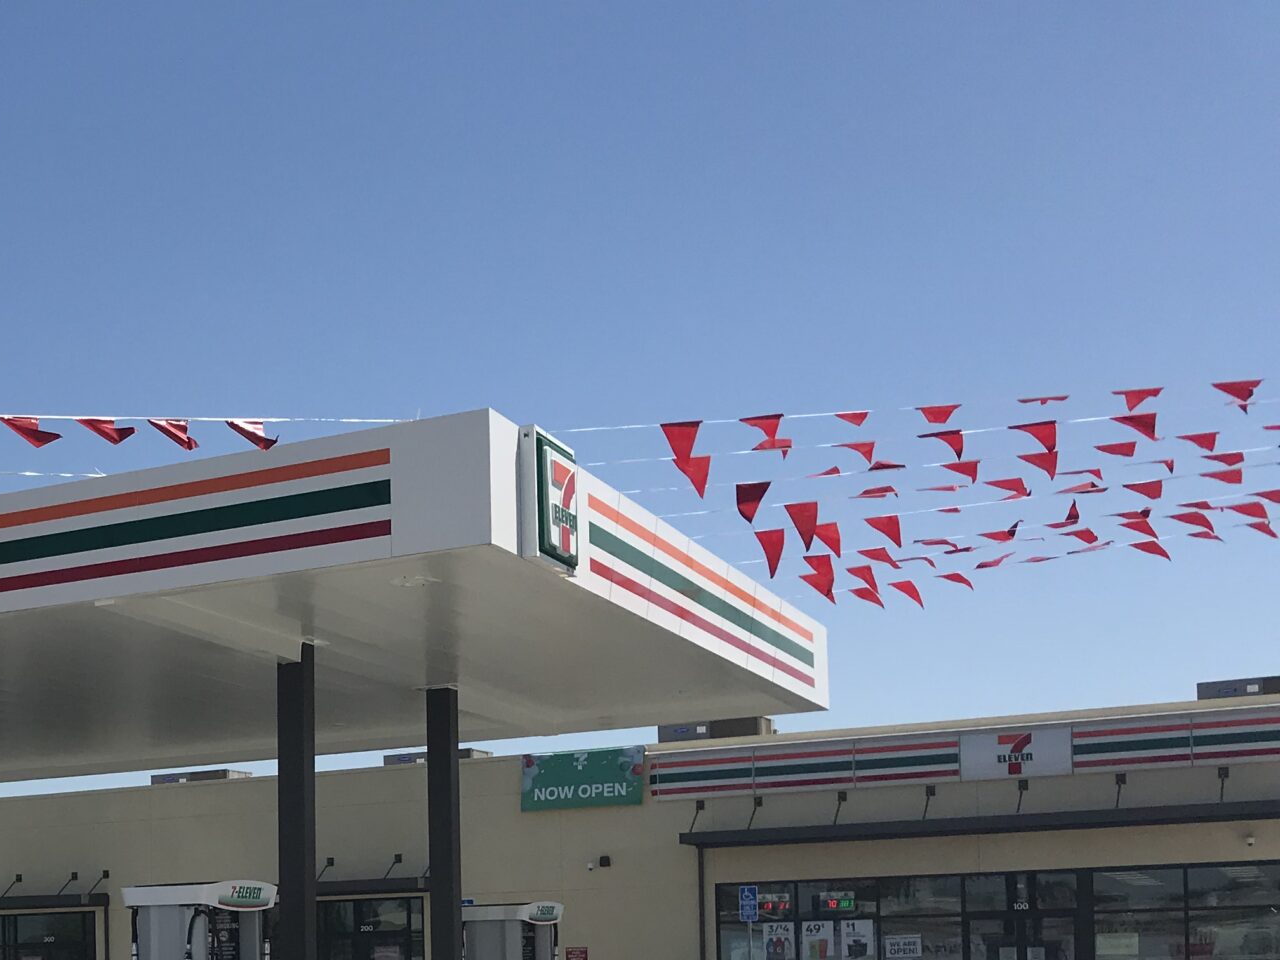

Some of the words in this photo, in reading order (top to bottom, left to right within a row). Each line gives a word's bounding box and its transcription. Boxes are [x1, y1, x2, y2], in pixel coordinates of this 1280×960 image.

[551, 459, 577, 554] 7
[997, 732, 1032, 776] 7
[534, 785, 575, 801] NOW
[578, 782, 627, 798] OPEN
[1013, 902, 1029, 910] 100
